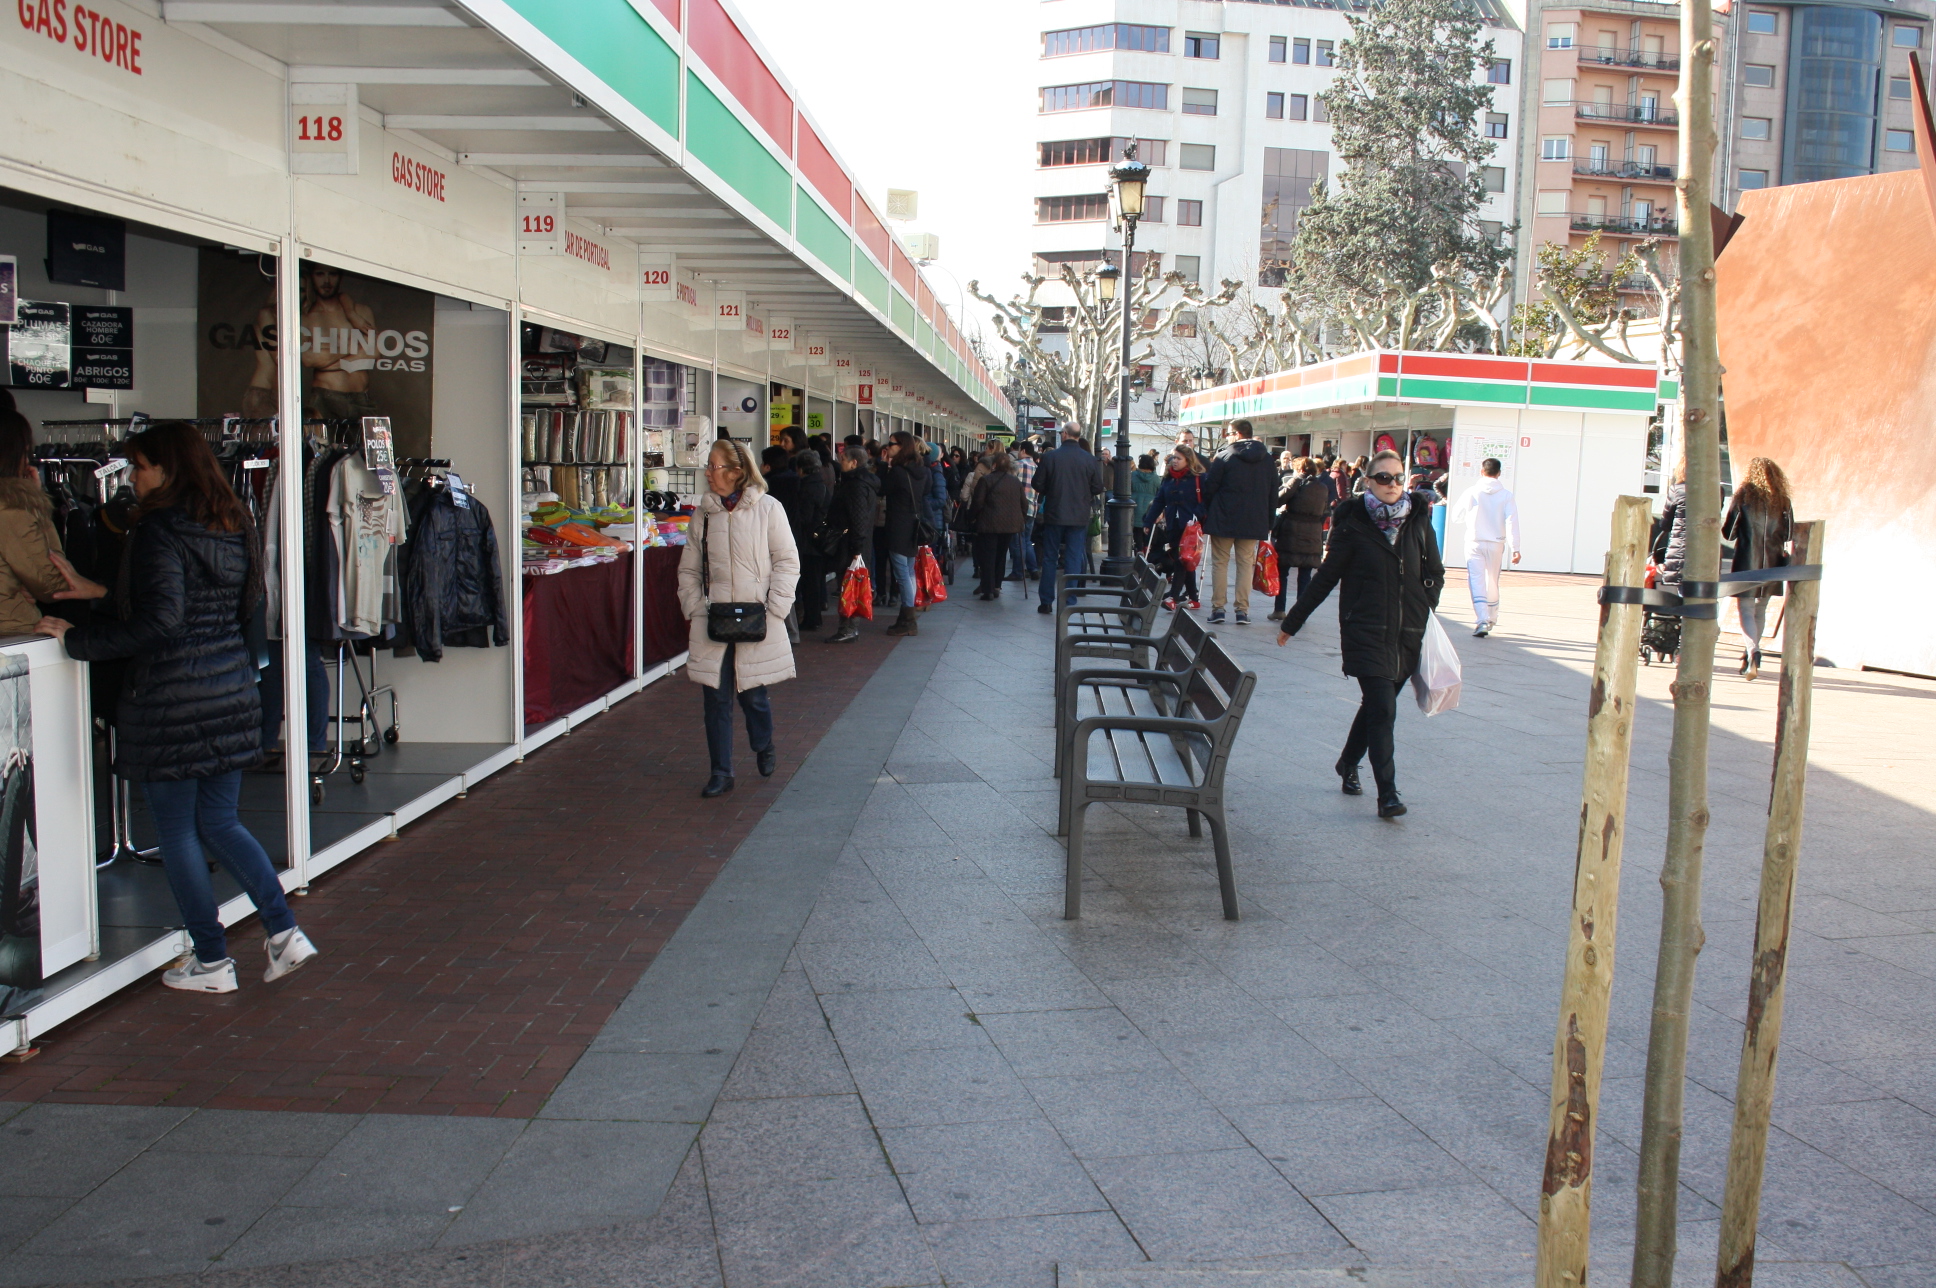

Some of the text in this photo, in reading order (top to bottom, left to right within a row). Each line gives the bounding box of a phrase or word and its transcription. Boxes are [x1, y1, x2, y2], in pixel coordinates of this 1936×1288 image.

[18, 0, 142, 76] GAS STORE
[298, 115, 343, 141] 118
[392, 151, 446, 202] GAS STORE
[522, 215, 554, 233] 119
[86, 244, 106, 254] GAS
[575, 234, 583, 260] DE
[583, 238, 611, 271] PORTUGAL
[643, 270, 669, 285] 120
[719, 304, 740, 316] 121
[17, 319, 63, 333] PLUMAS
[81, 320, 123, 329] CAZADORA
[91, 334, 114, 344] 60€
[208, 322, 278, 351] GAS
[771, 329, 789, 339] 122
[808, 346, 824, 355] 123
[17, 358, 61, 368] CHAQUETA
[376, 358, 426, 373] GAS
[836, 359, 851, 367] 124
[25, 365, 54, 374] PUNTO
[76, 366, 129, 377] ABRIGOS
[28, 373, 52, 384] 60€
[367, 438, 385, 450] POLOS
